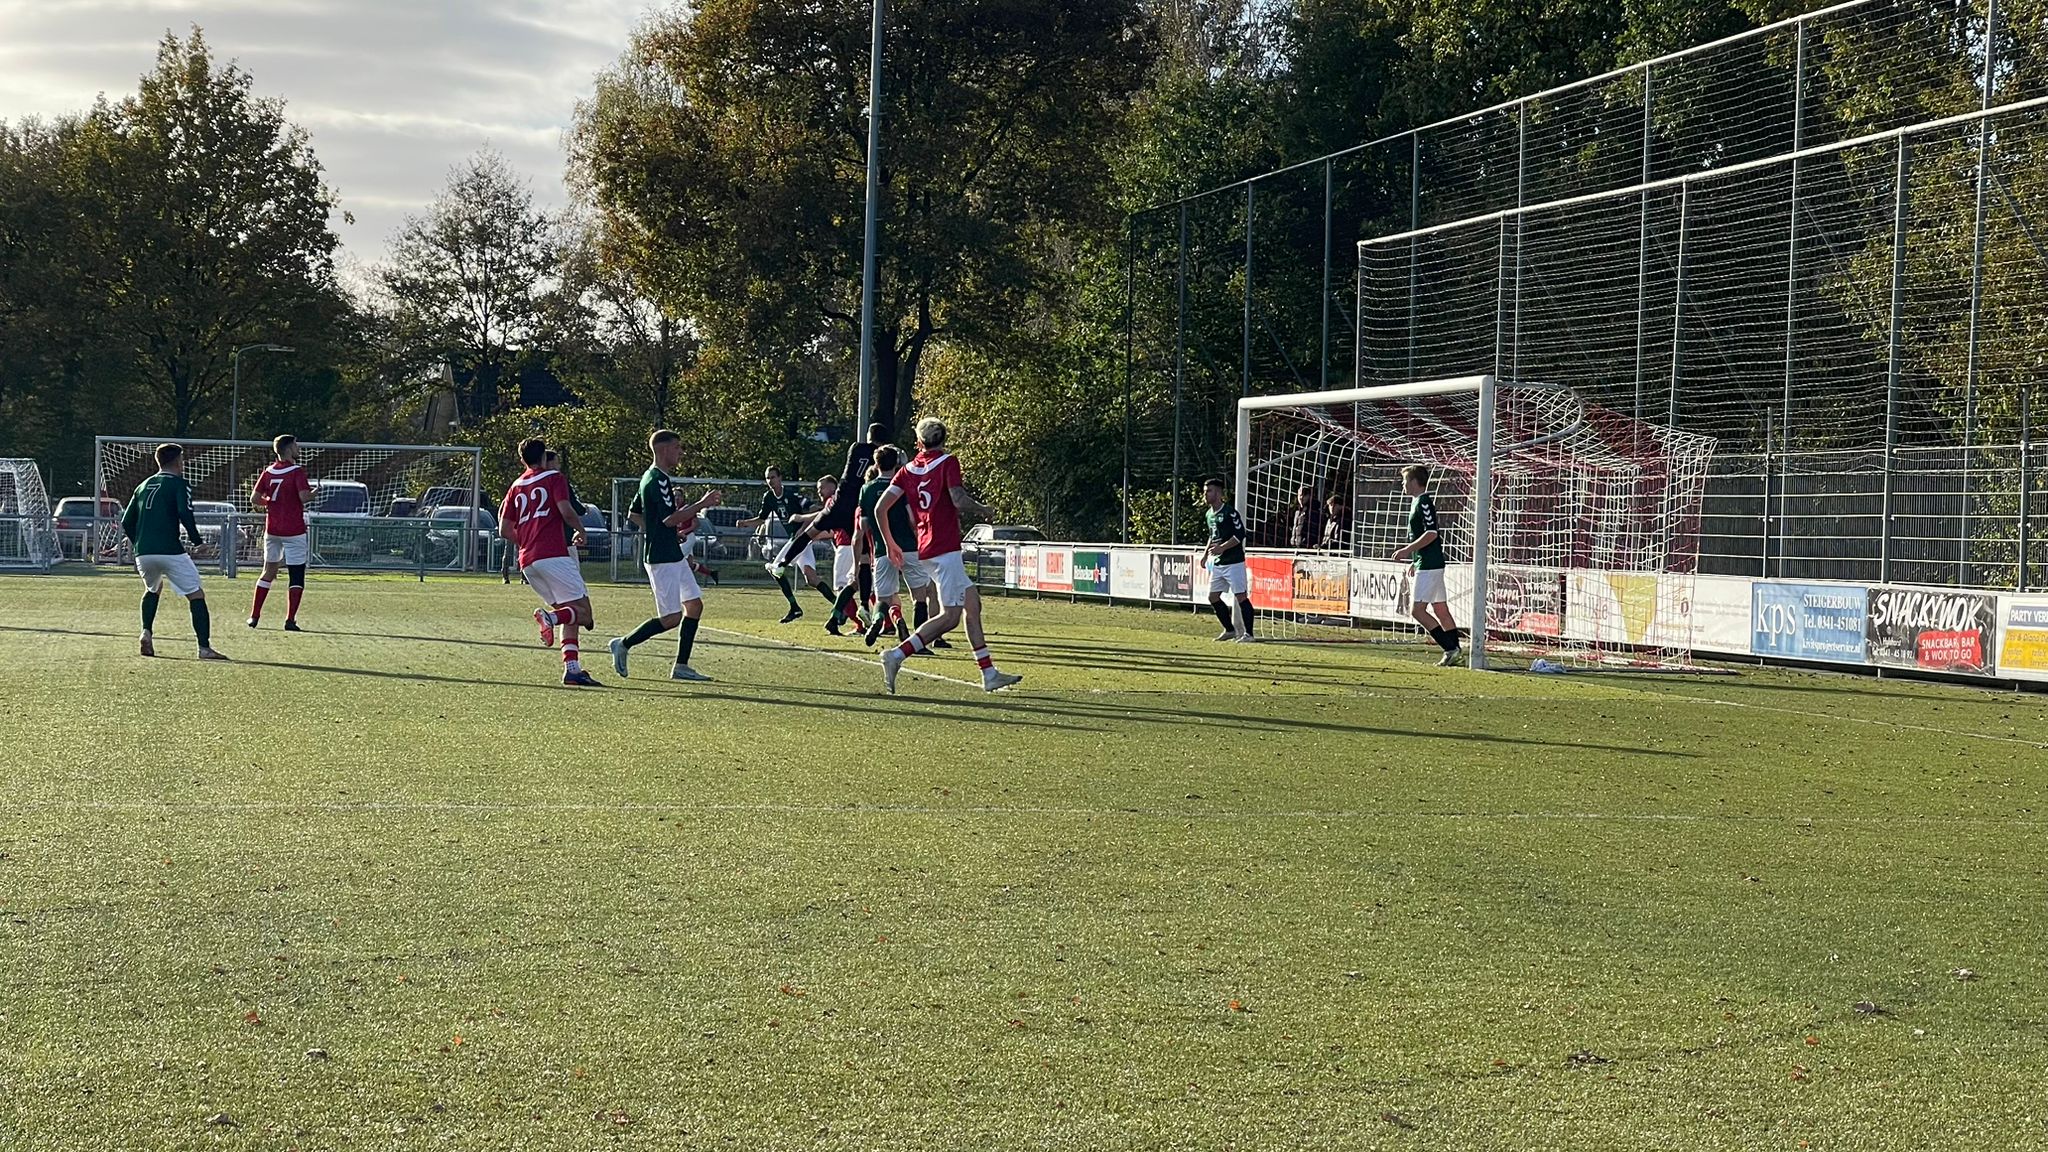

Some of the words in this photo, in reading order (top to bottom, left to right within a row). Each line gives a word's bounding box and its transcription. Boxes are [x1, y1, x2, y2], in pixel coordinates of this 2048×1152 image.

[856, 458, 870, 478] 1
[145, 483, 162, 510] 7
[269, 478, 284, 502] 7
[917, 478, 932, 510] 5
[514, 486, 551, 525] 22
[1163, 557, 1171, 576] de
[1171, 557, 1191, 581] kapper
[1803, 593, 1861, 610] STEIGERBOUW
[1756, 588, 1796, 647] kps
[1803, 614, 1817, 629] Tel.
[1817, 615, 1861, 632] 0341-451081
[2010, 609, 2032, 623] PARTY
[2033, 610, 2048, 623] VER
[1961, 637, 1975, 648] BAR
[1924, 650, 1930, 661] &
[1931, 650, 1948, 661] WOK
[1949, 649, 1959, 660] TO
[1960, 648, 1972, 660] GO
